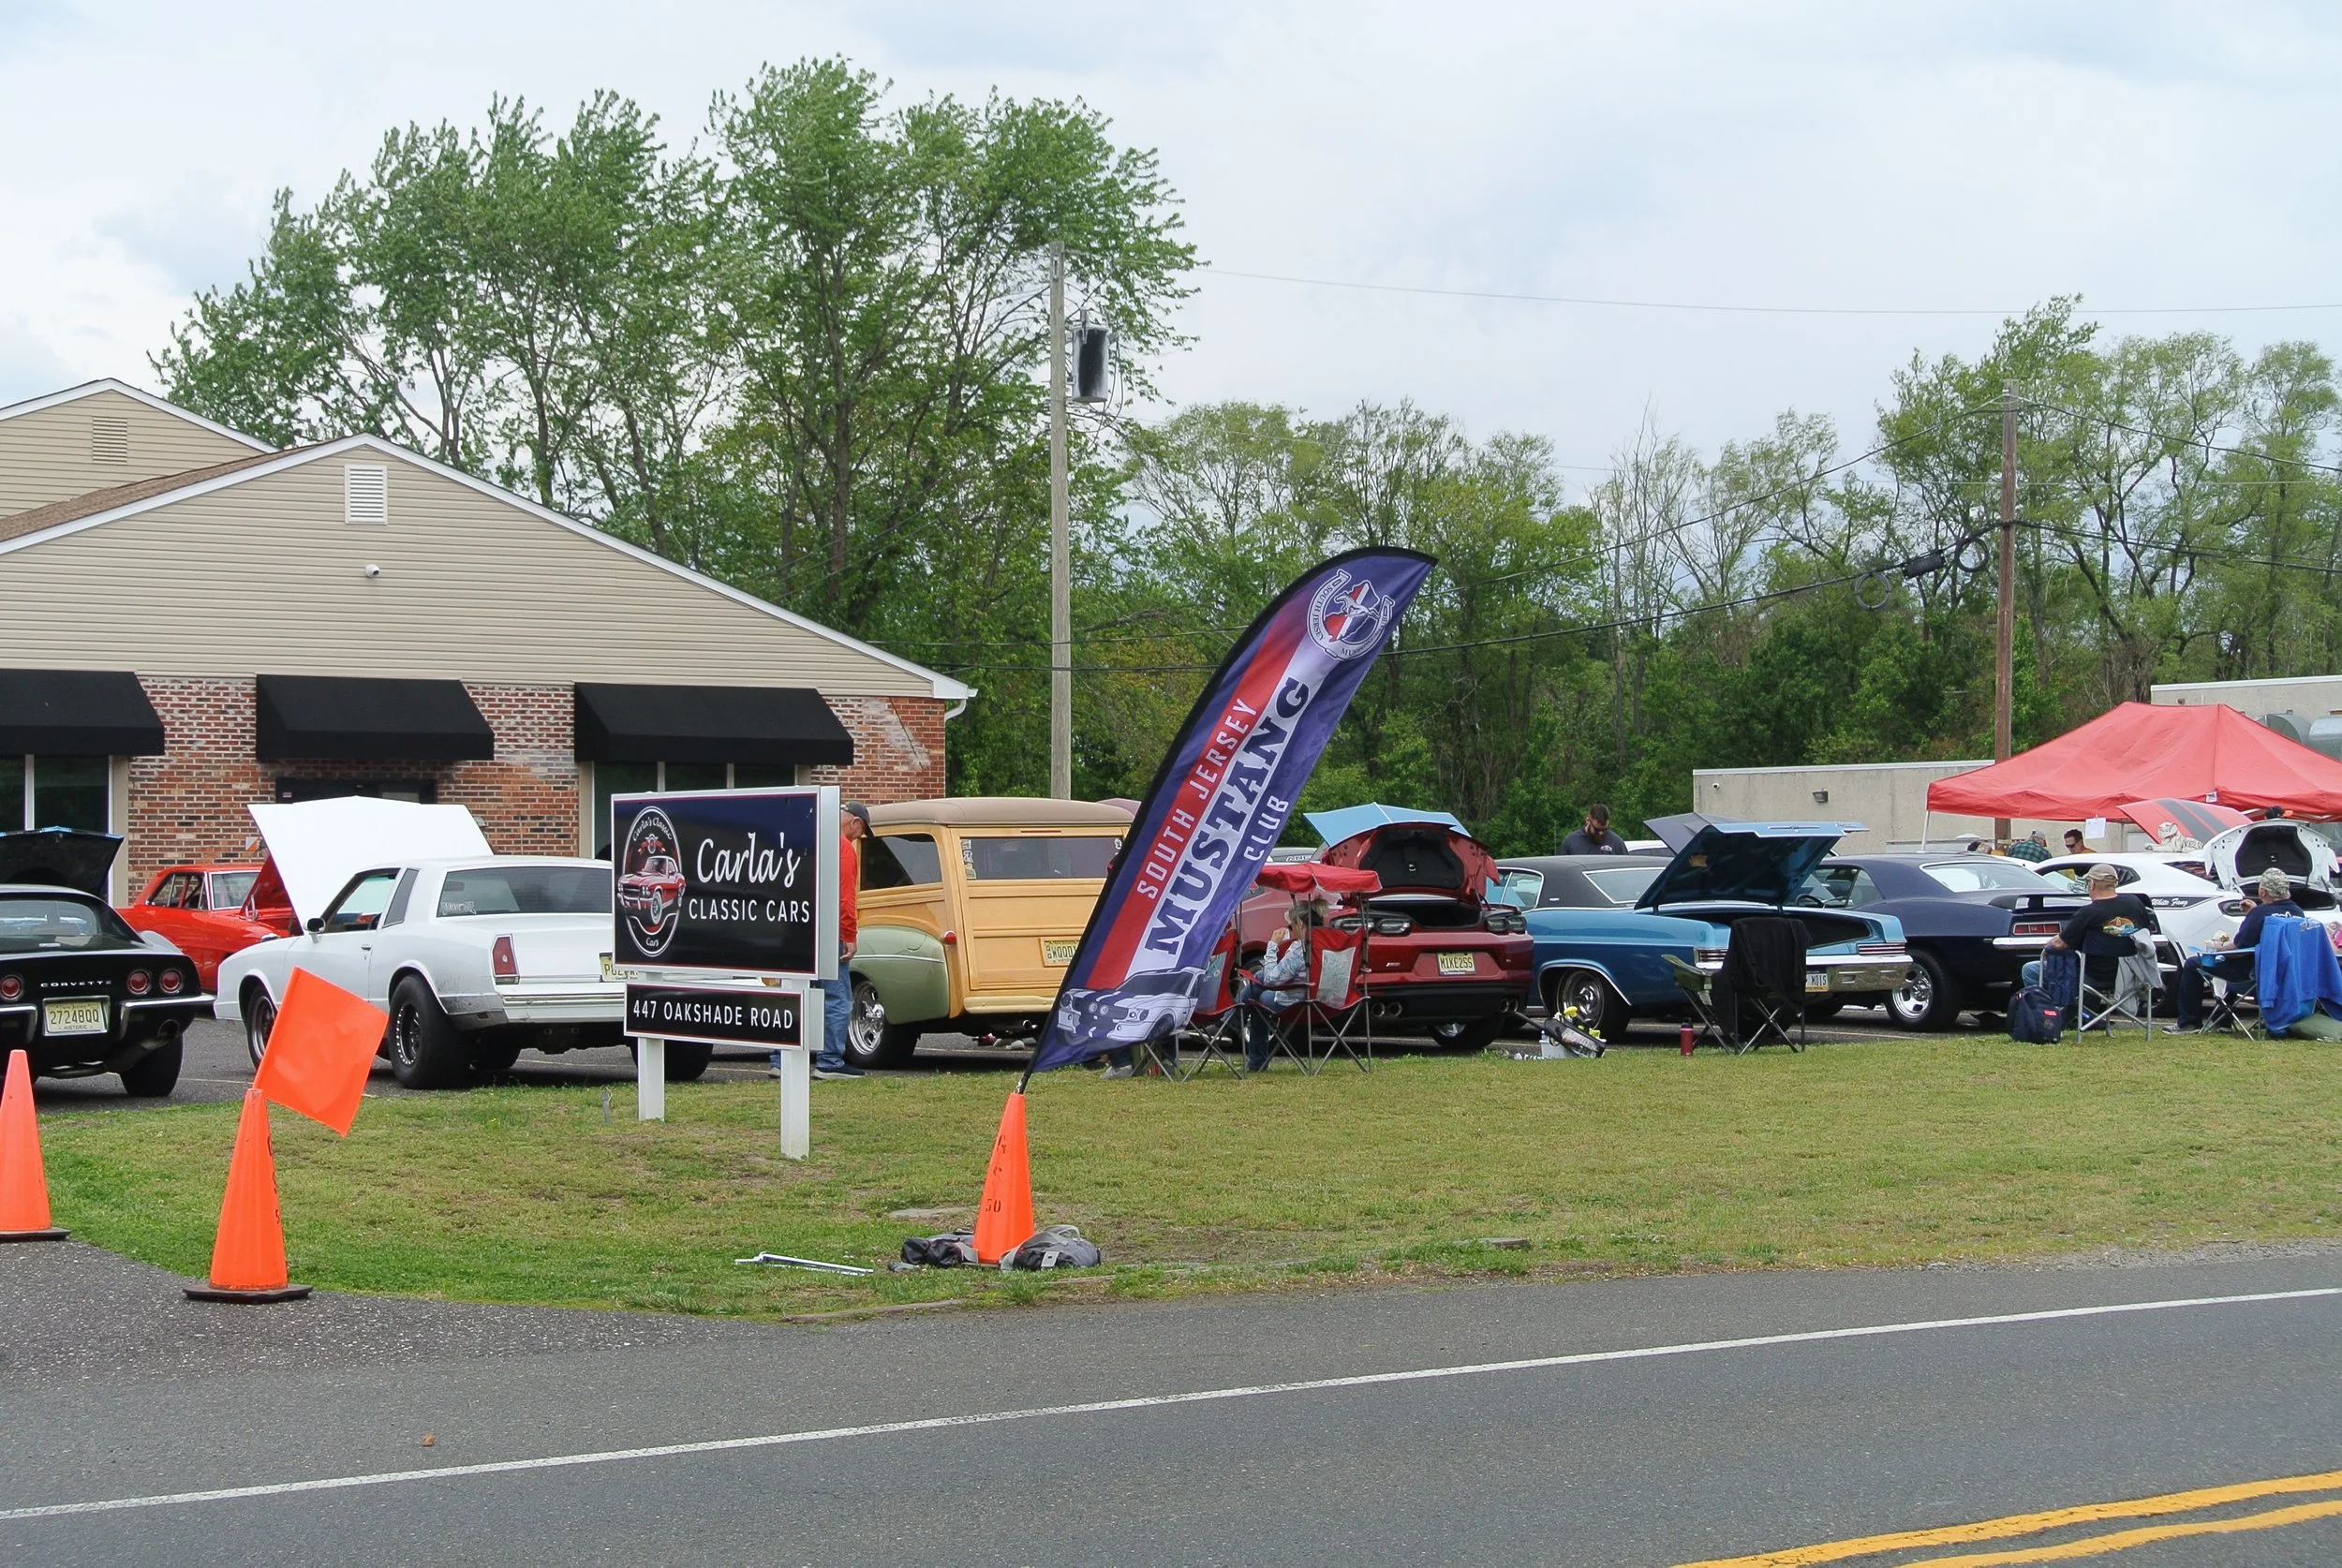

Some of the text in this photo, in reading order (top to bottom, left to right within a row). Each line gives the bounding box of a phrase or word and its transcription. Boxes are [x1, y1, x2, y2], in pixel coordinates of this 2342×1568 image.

[1136, 698, 1256, 899] SOUTH JERSEY
[1145, 677, 1310, 955] MUSTANG
[1244, 795, 1289, 861] CLUB
[697, 832, 801, 888] Carla's
[689, 898, 810, 923] CLASSIC CARS
[632, 999, 793, 1029] 447 OAKSHADE ROAD
